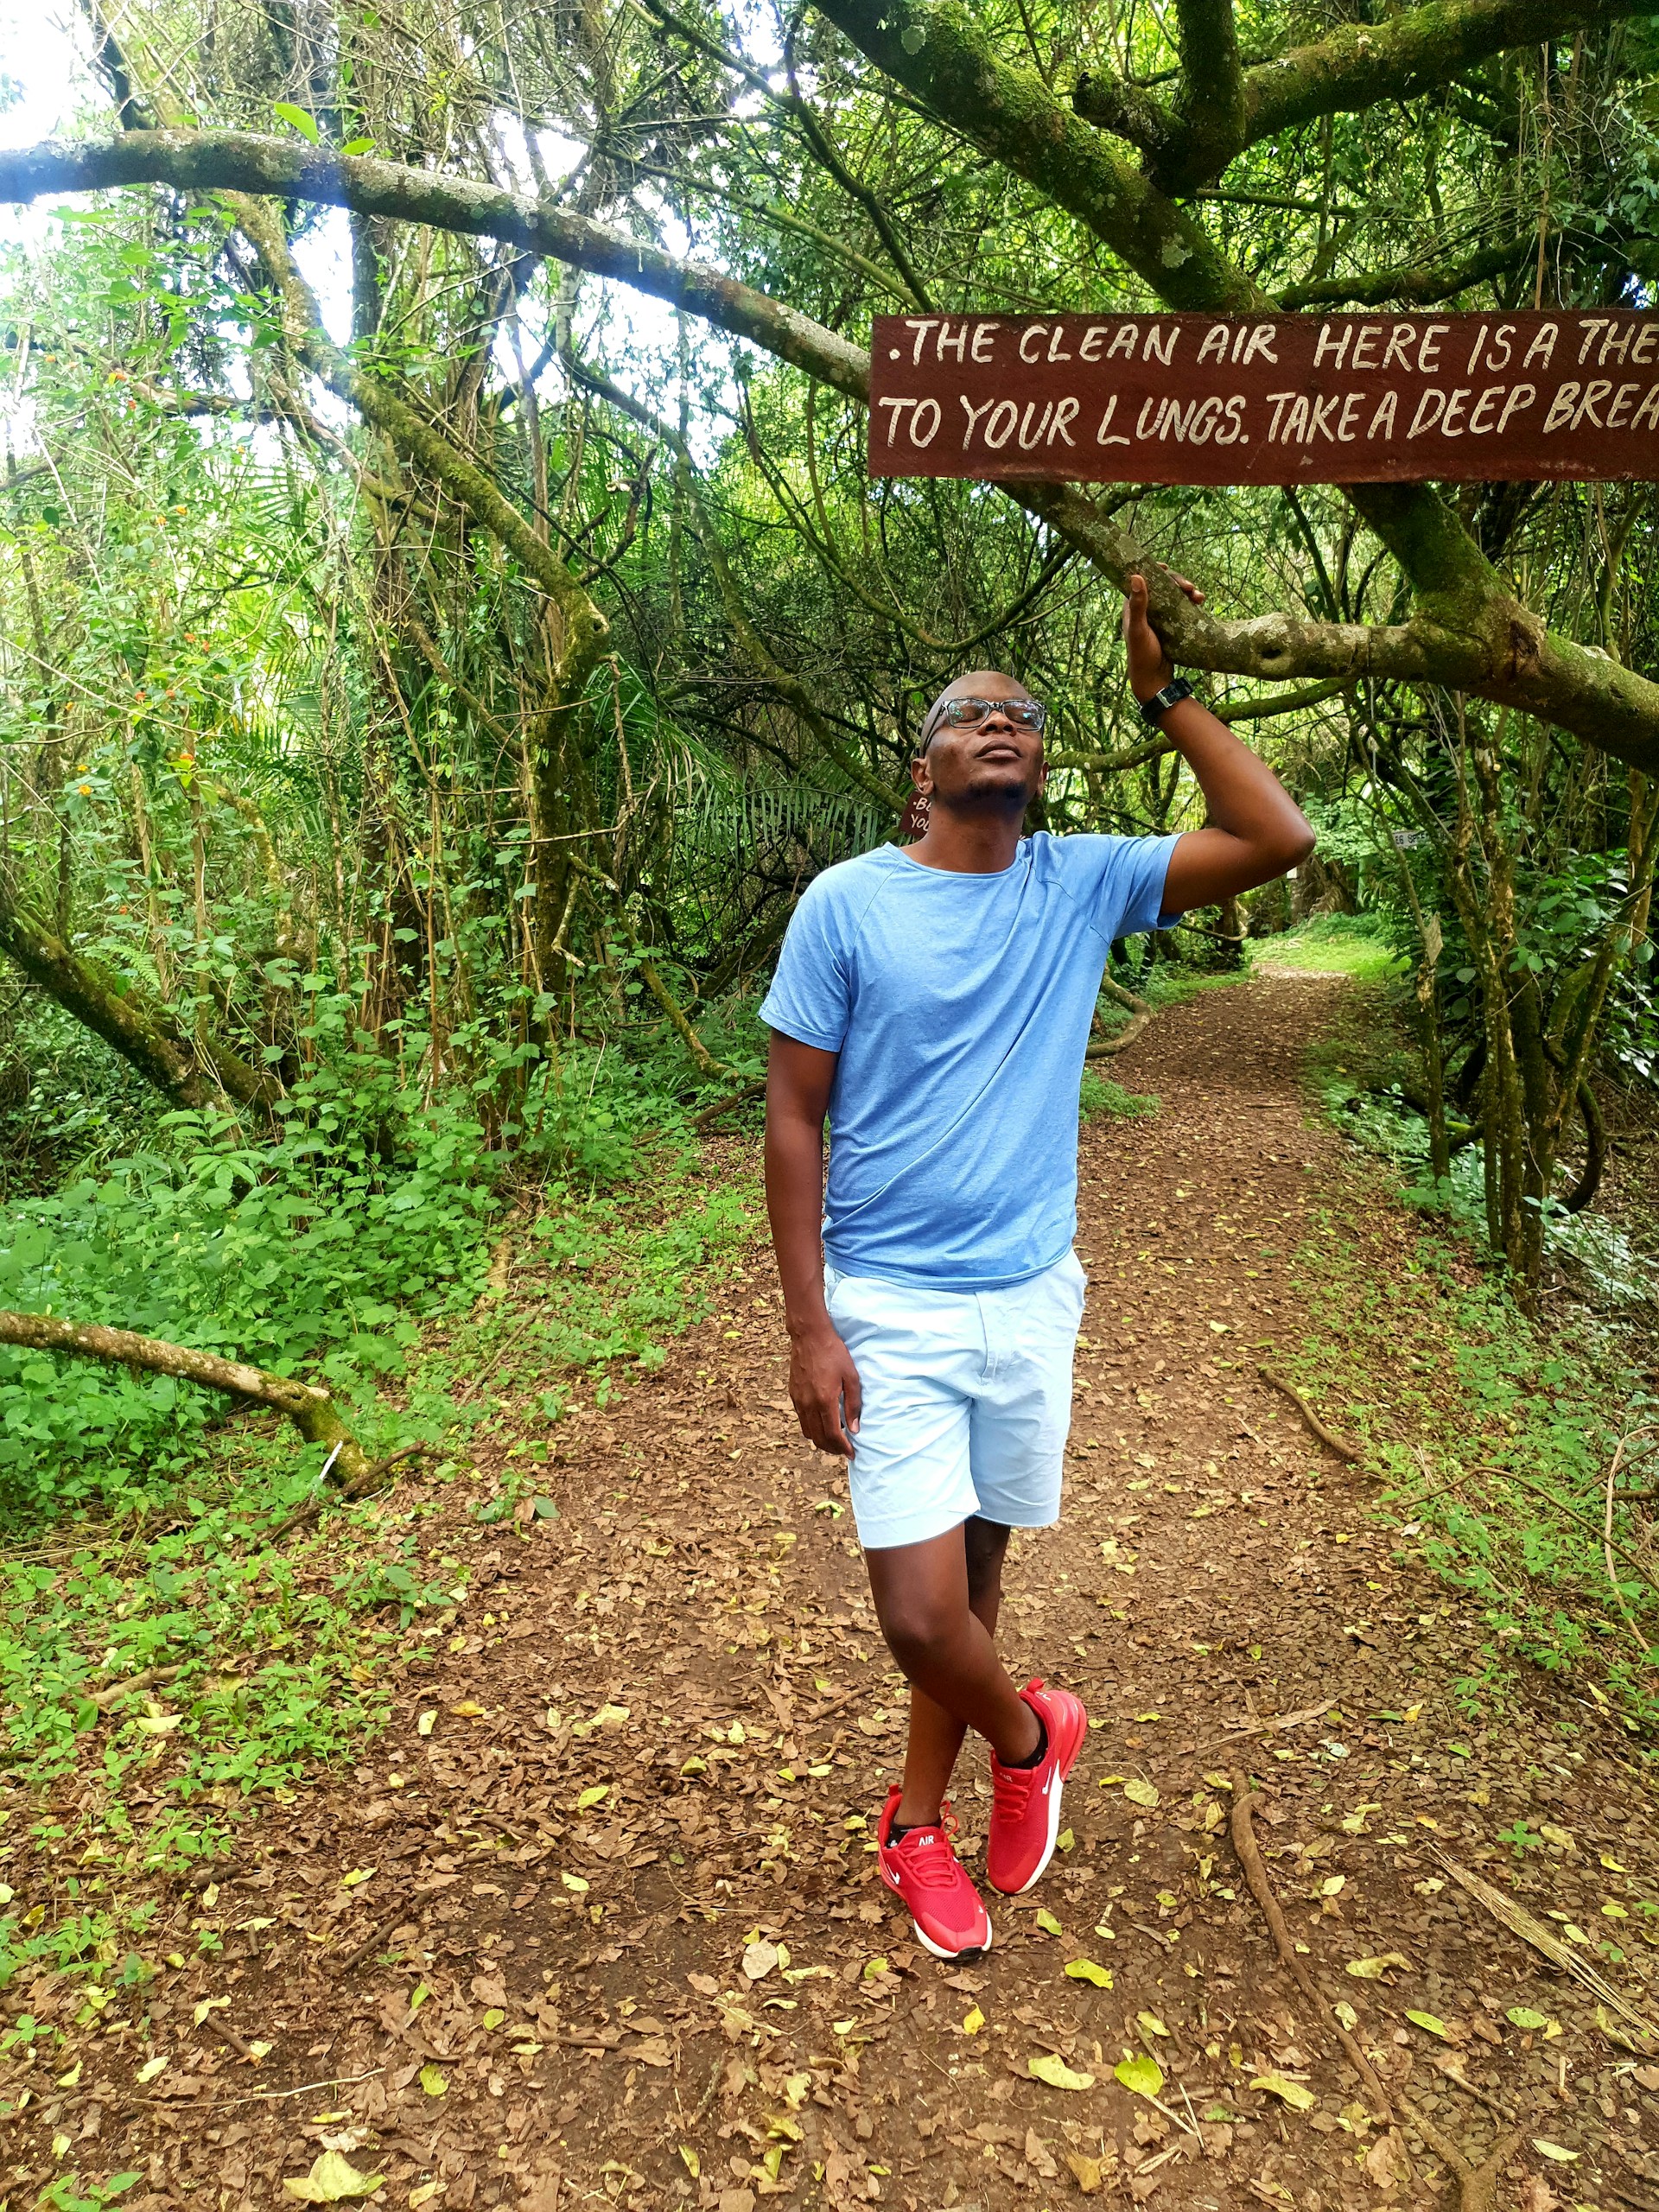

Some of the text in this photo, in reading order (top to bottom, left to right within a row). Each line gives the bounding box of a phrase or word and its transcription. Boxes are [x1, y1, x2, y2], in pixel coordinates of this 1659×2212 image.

[1019, 324, 1181, 366] CLEAN
[1196, 324, 1279, 365] AIR
[1313, 322, 1452, 373] HERE
[1466, 323, 1516, 375] IS
[1522, 322, 1559, 370] A
[1578, 318, 1659, 366] THE
[878, 396, 942, 449] TO
[959, 394, 1081, 451] YOUR
[1096, 394, 1249, 446] LUNGS.
[1265, 391, 1367, 445] TAKE
[1367, 391, 1398, 441] A
[1406, 383, 1536, 441] DEEP
[918, 1834, 935, 1847] AIR
